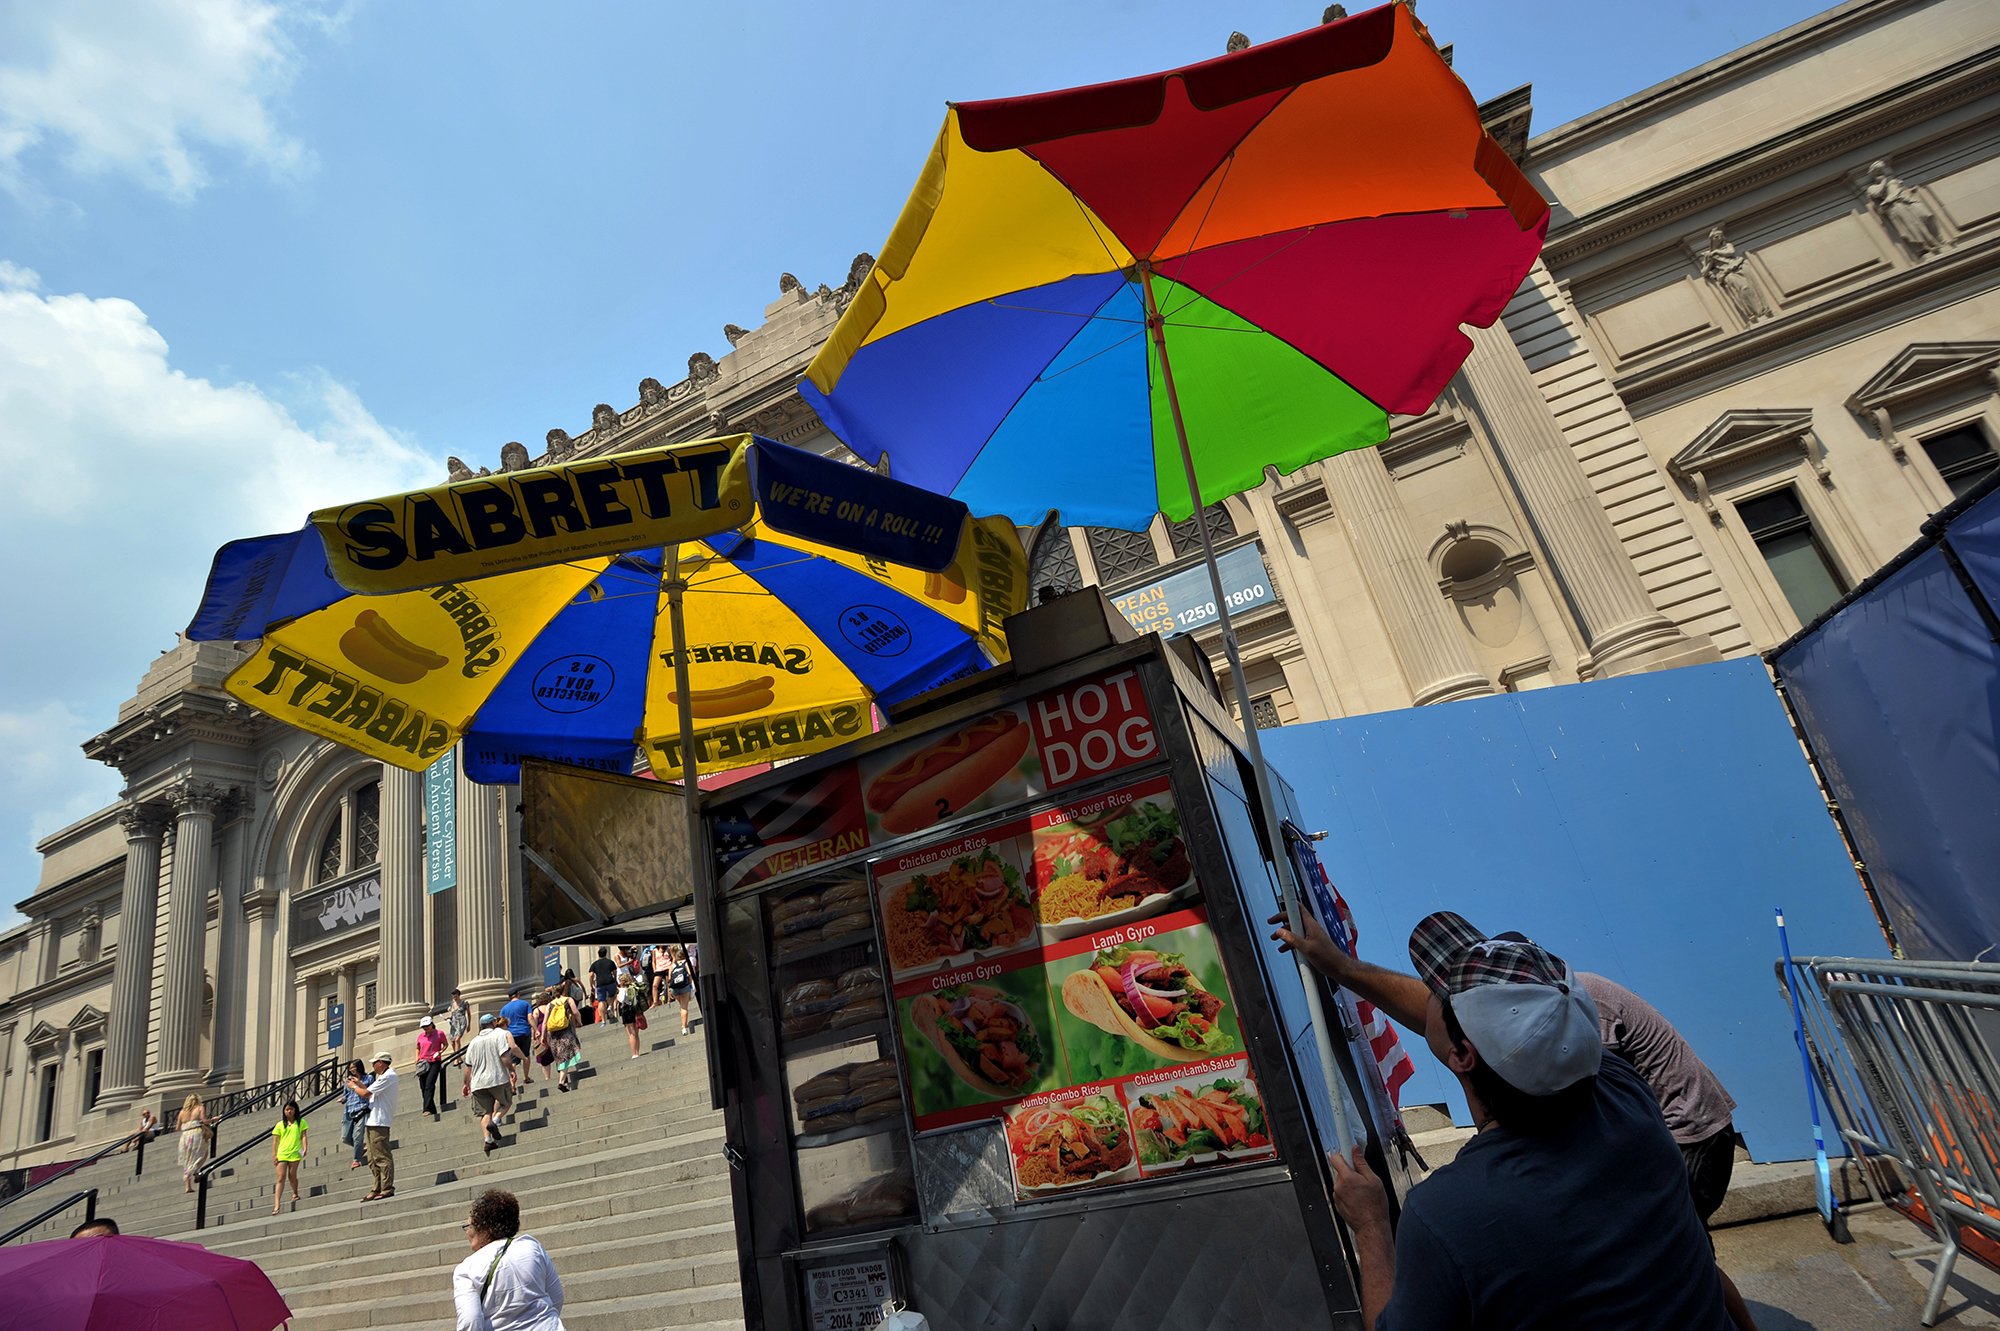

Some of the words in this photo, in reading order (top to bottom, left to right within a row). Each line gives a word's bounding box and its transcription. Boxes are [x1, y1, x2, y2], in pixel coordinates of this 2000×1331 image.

[336, 442, 731, 570] SABRETT
[770, 480, 834, 515] WE'RE
[836, 501, 864, 524] ON
[866, 508, 878, 528] A
[880, 512, 920, 538] ROLL
[921, 524, 944, 544] !!!
[495, 555, 522, 567] Umbrella
[539, 547, 563, 558] Property
[1177, 602, 1216, 625] 1250
[1224, 584, 1264, 609] 1800
[1037, 670, 1134, 738] HOT
[441, 752, 452, 775] The
[1044, 716, 1157, 785] DOG
[430, 762, 438, 779] nd
[430, 784, 442, 836] Ancient
[441, 778, 453, 817] Cyrus
[935, 798, 953, 819] 2
[1048, 808, 1079, 827] Lamb
[1081, 802, 1104, 817] over
[1107, 792, 1133, 809] Rice
[432, 839, 443, 882] Persia
[442, 820, 454, 879] Cylinder
[766, 828, 865, 876] VETERAN
[898, 850, 938, 871] Chicken
[940, 845, 963, 860] over
[964, 836, 988, 852] Rice
[318, 879, 376, 918] PUNK
[1092, 932, 1124, 951] Lamb
[1126, 924, 1156, 943] Gyro
[932, 970, 974, 991] Chicken
[976, 963, 1002, 982] Gyro
[1134, 1072, 1170, 1087] Chicken
[1172, 1069, 1182, 1079] or
[1184, 1062, 1208, 1077] Lamb
[1210, 1056, 1237, 1072] Salad
[1021, 1096, 1048, 1109] Jumbo
[1050, 1088, 1080, 1102] Combo
[1081, 1085, 1101, 1098] Rice
[812, 1270, 835, 1280] MOBILE
[838, 1268, 855, 1276] FOOD
[857, 1264, 883, 1274] VENDOR
[868, 1273, 887, 1282] NYC
[834, 1289, 867, 1302] C3341
[830, 1313, 853, 1330] 2014
